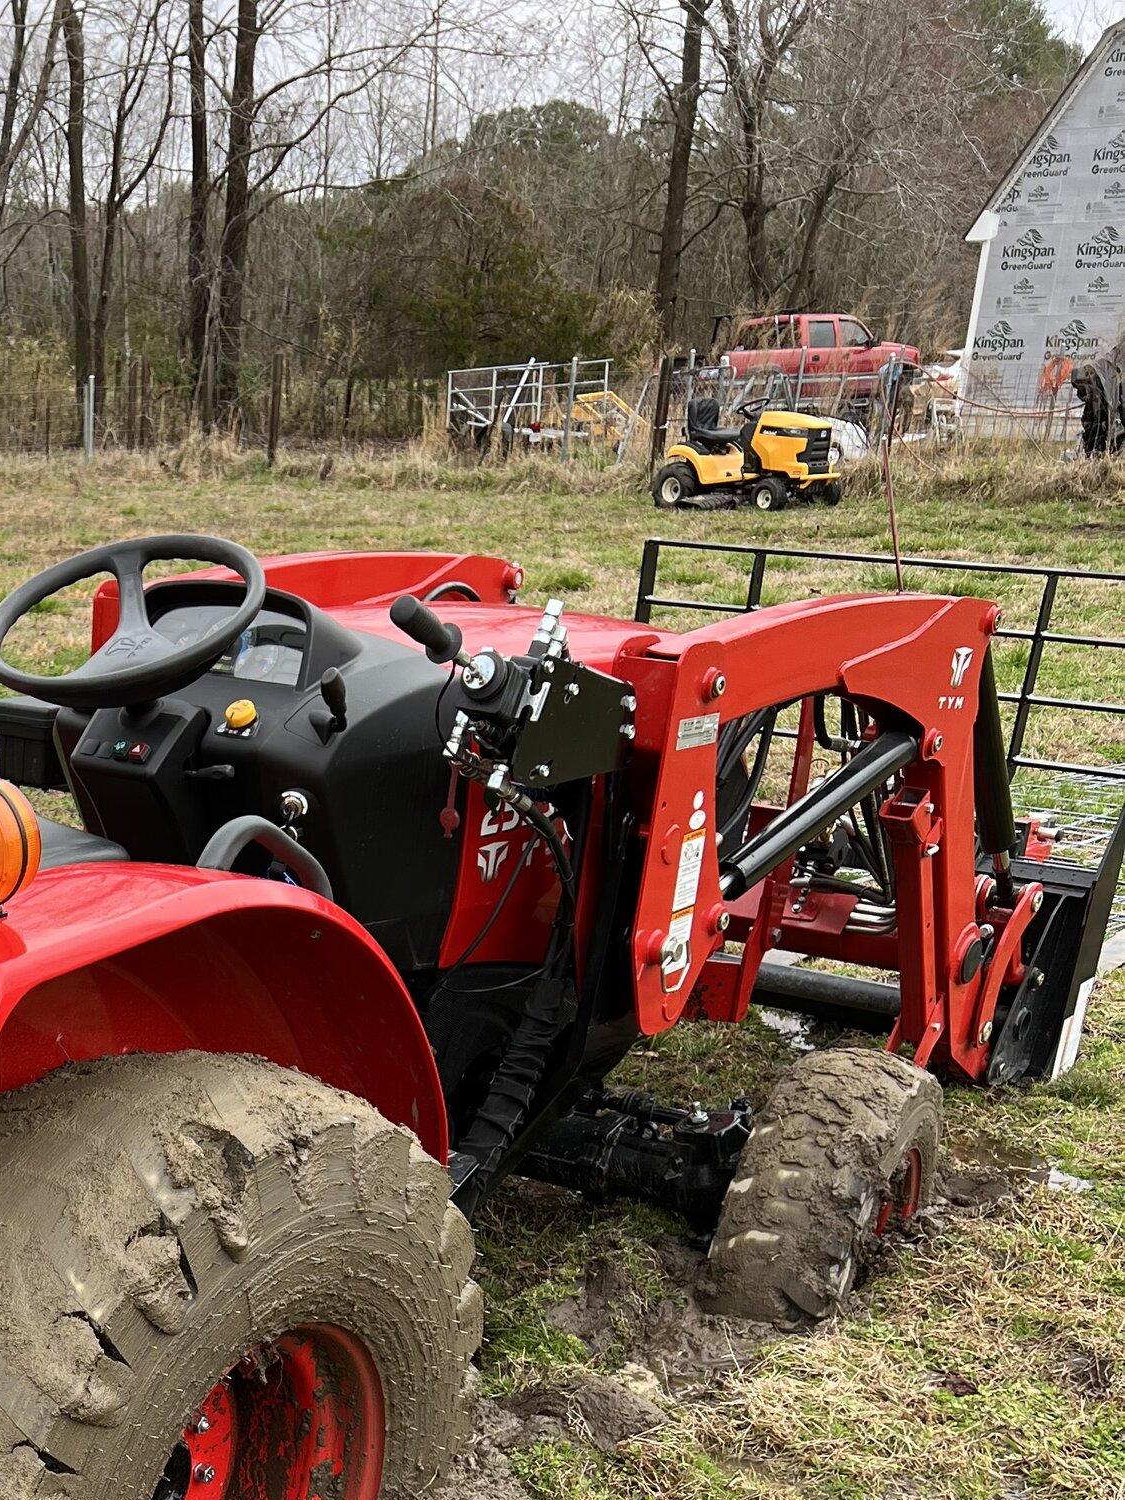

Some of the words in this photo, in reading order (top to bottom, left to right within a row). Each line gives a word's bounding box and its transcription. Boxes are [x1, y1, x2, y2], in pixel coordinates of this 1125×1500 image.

[1093, 147, 1125, 164] Kings
[1002, 244, 1056, 260] Kingspan
[1076, 242, 1125, 258] Kingspa
[1001, 260, 1053, 271] GreenGuard
[1075, 259, 1125, 268] GreenGuar
[973, 336, 1025, 351] Kingspan
[938, 696, 965, 710] TYM
